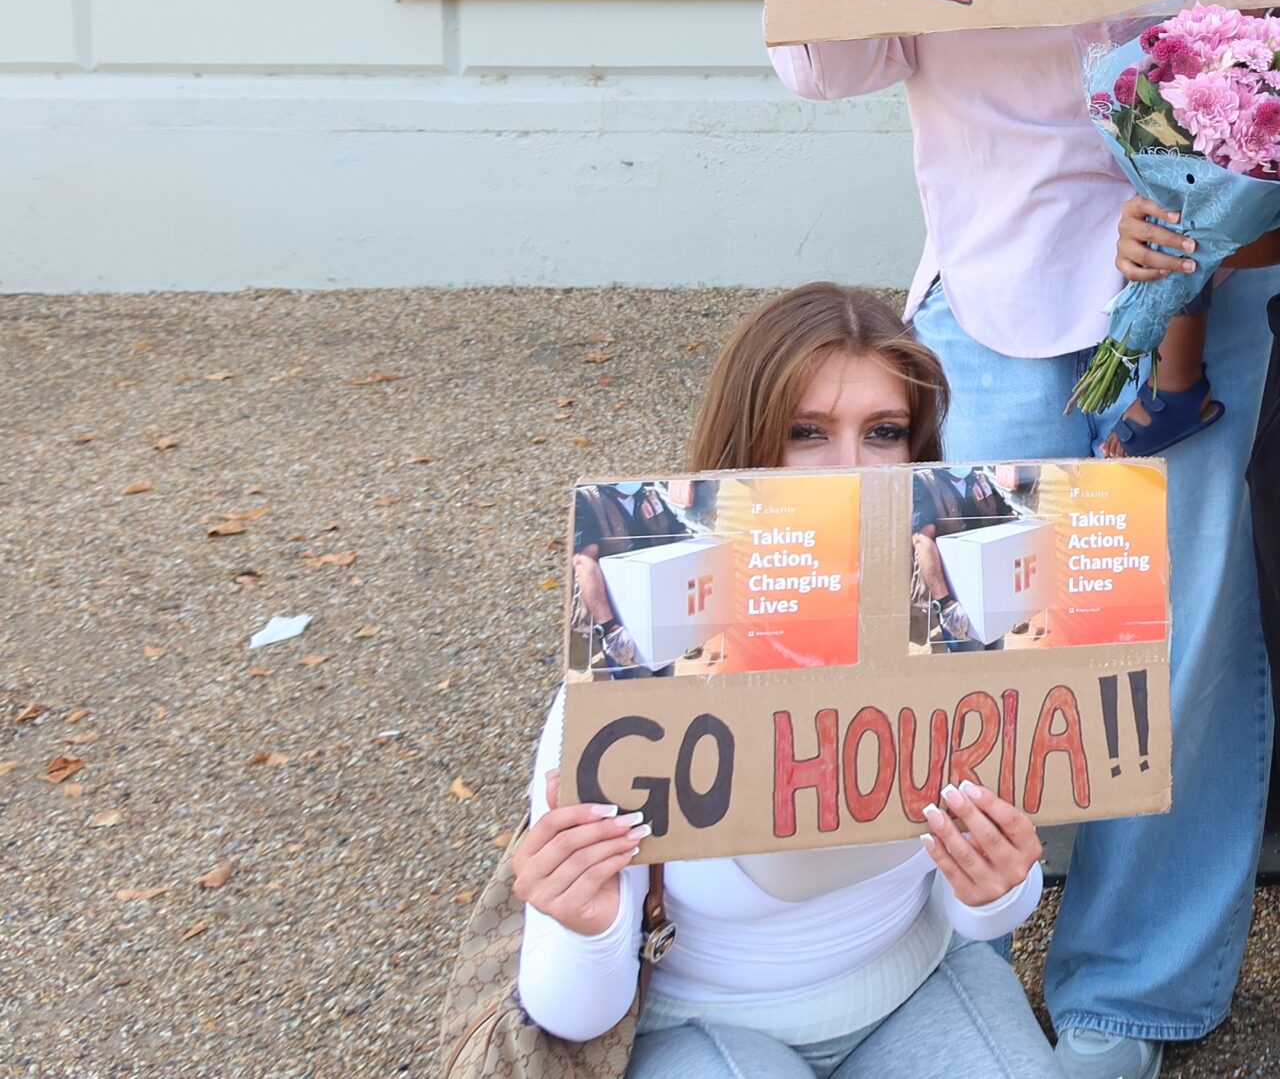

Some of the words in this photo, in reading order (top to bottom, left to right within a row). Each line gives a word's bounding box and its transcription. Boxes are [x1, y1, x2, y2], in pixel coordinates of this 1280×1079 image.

[1068, 509, 1127, 530] Taking
[749, 526, 816, 548] Taking
[1067, 531, 1130, 551] Action,
[747, 549, 819, 570] Action,
[1068, 551, 1151, 573] Changing
[748, 570, 842, 594] Changing
[1068, 575, 1113, 593] Lives
[748, 596, 799, 615] Lives
[575, 712, 735, 838] GO
